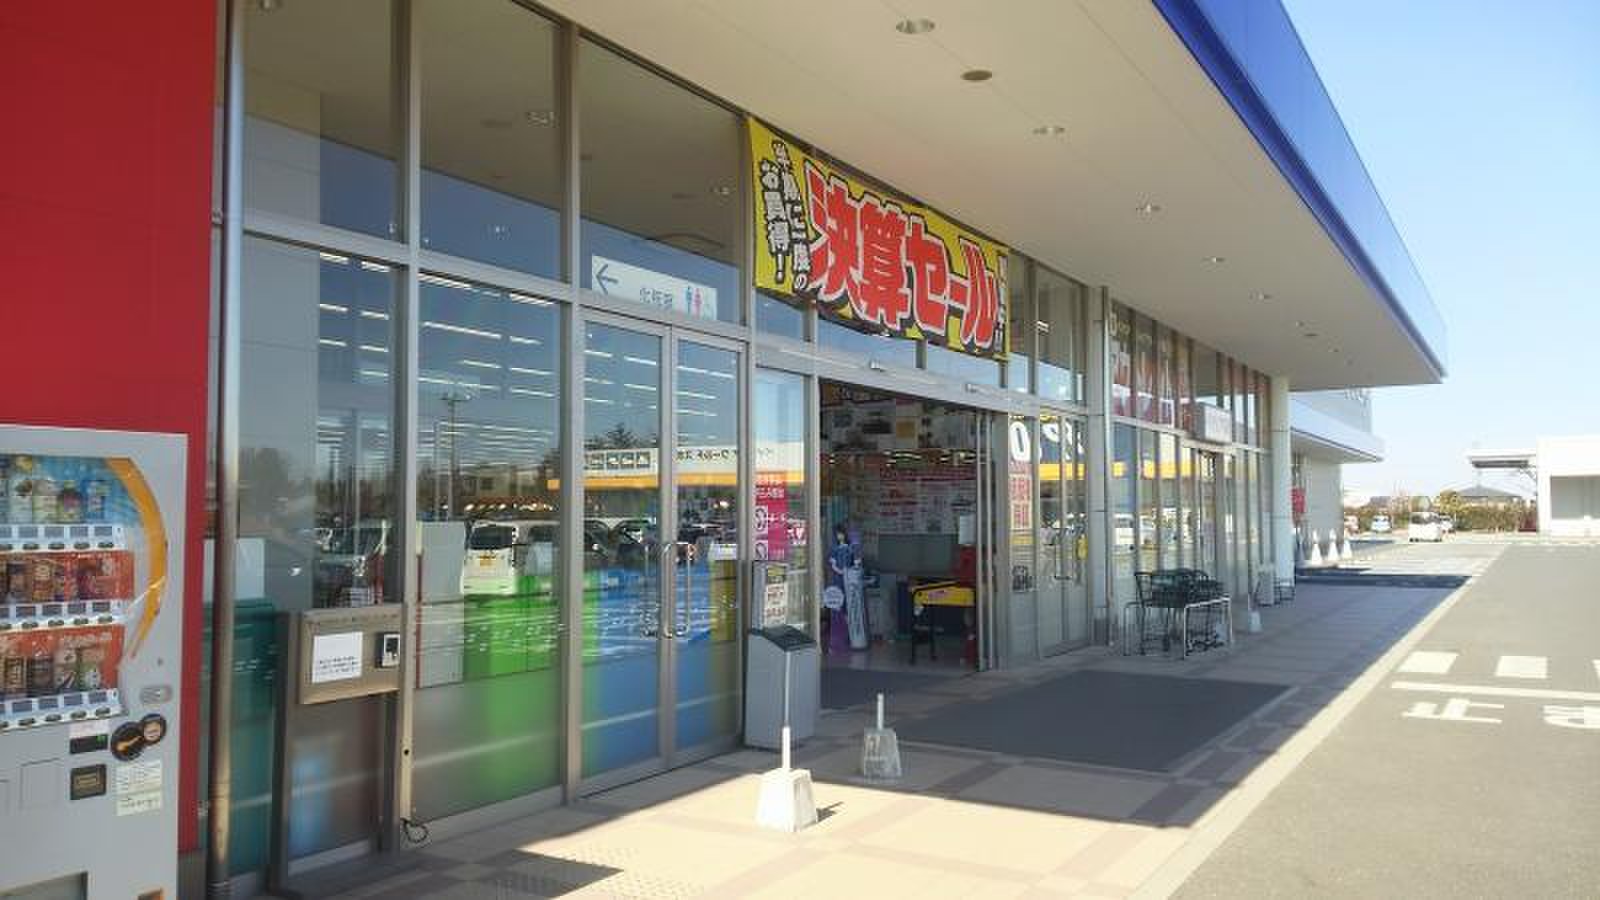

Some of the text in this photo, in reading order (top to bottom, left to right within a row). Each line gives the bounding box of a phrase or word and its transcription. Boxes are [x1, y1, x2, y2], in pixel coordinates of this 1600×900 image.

[804, 160, 995, 348] 決算セール
